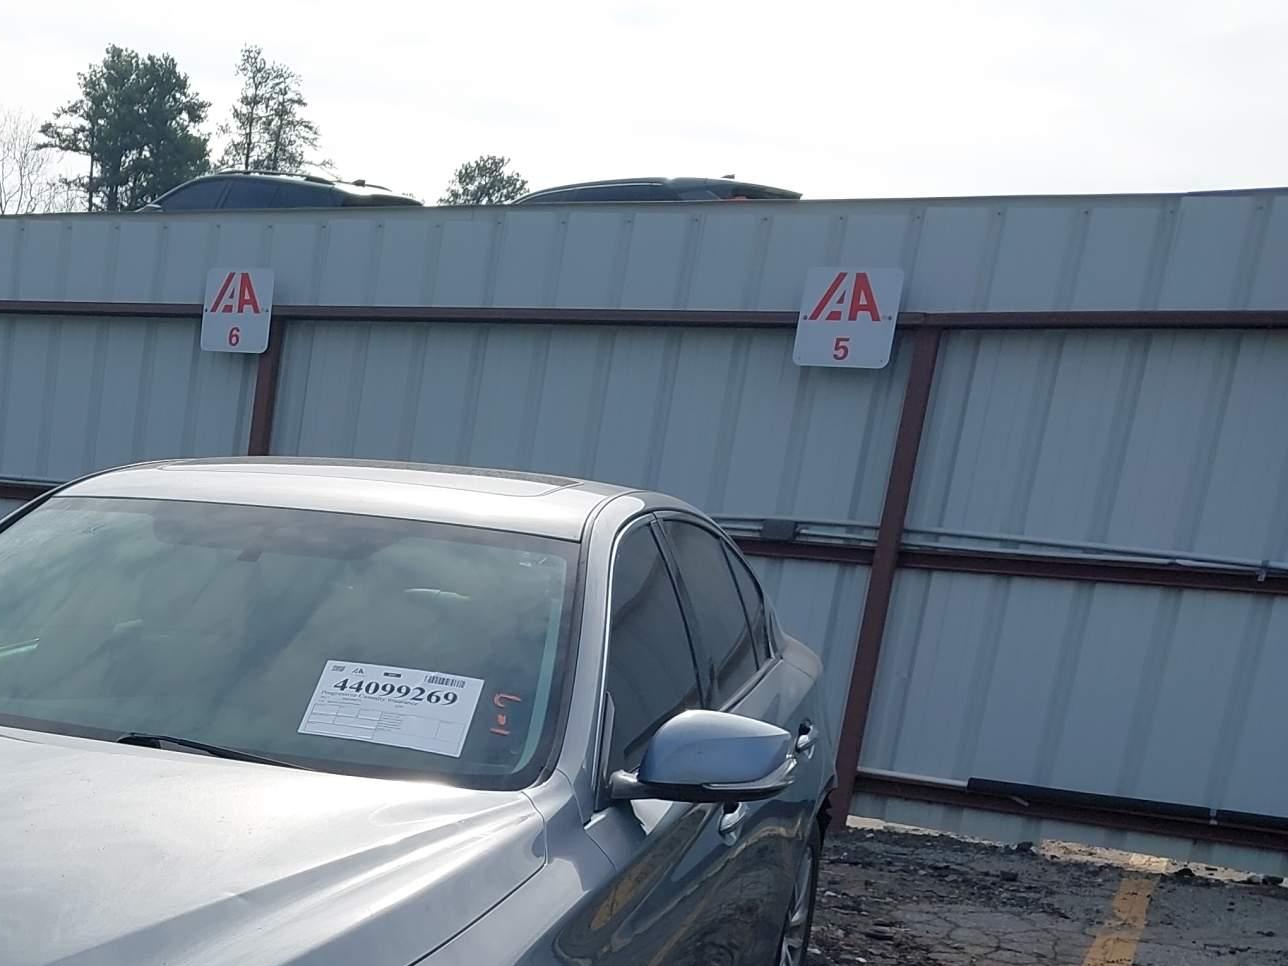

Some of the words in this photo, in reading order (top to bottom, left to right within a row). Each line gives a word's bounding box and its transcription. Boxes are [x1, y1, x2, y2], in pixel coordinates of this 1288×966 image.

[228, 327, 241, 347] 6
[833, 337, 850, 360] 5
[333, 679, 459, 706] 44099269
